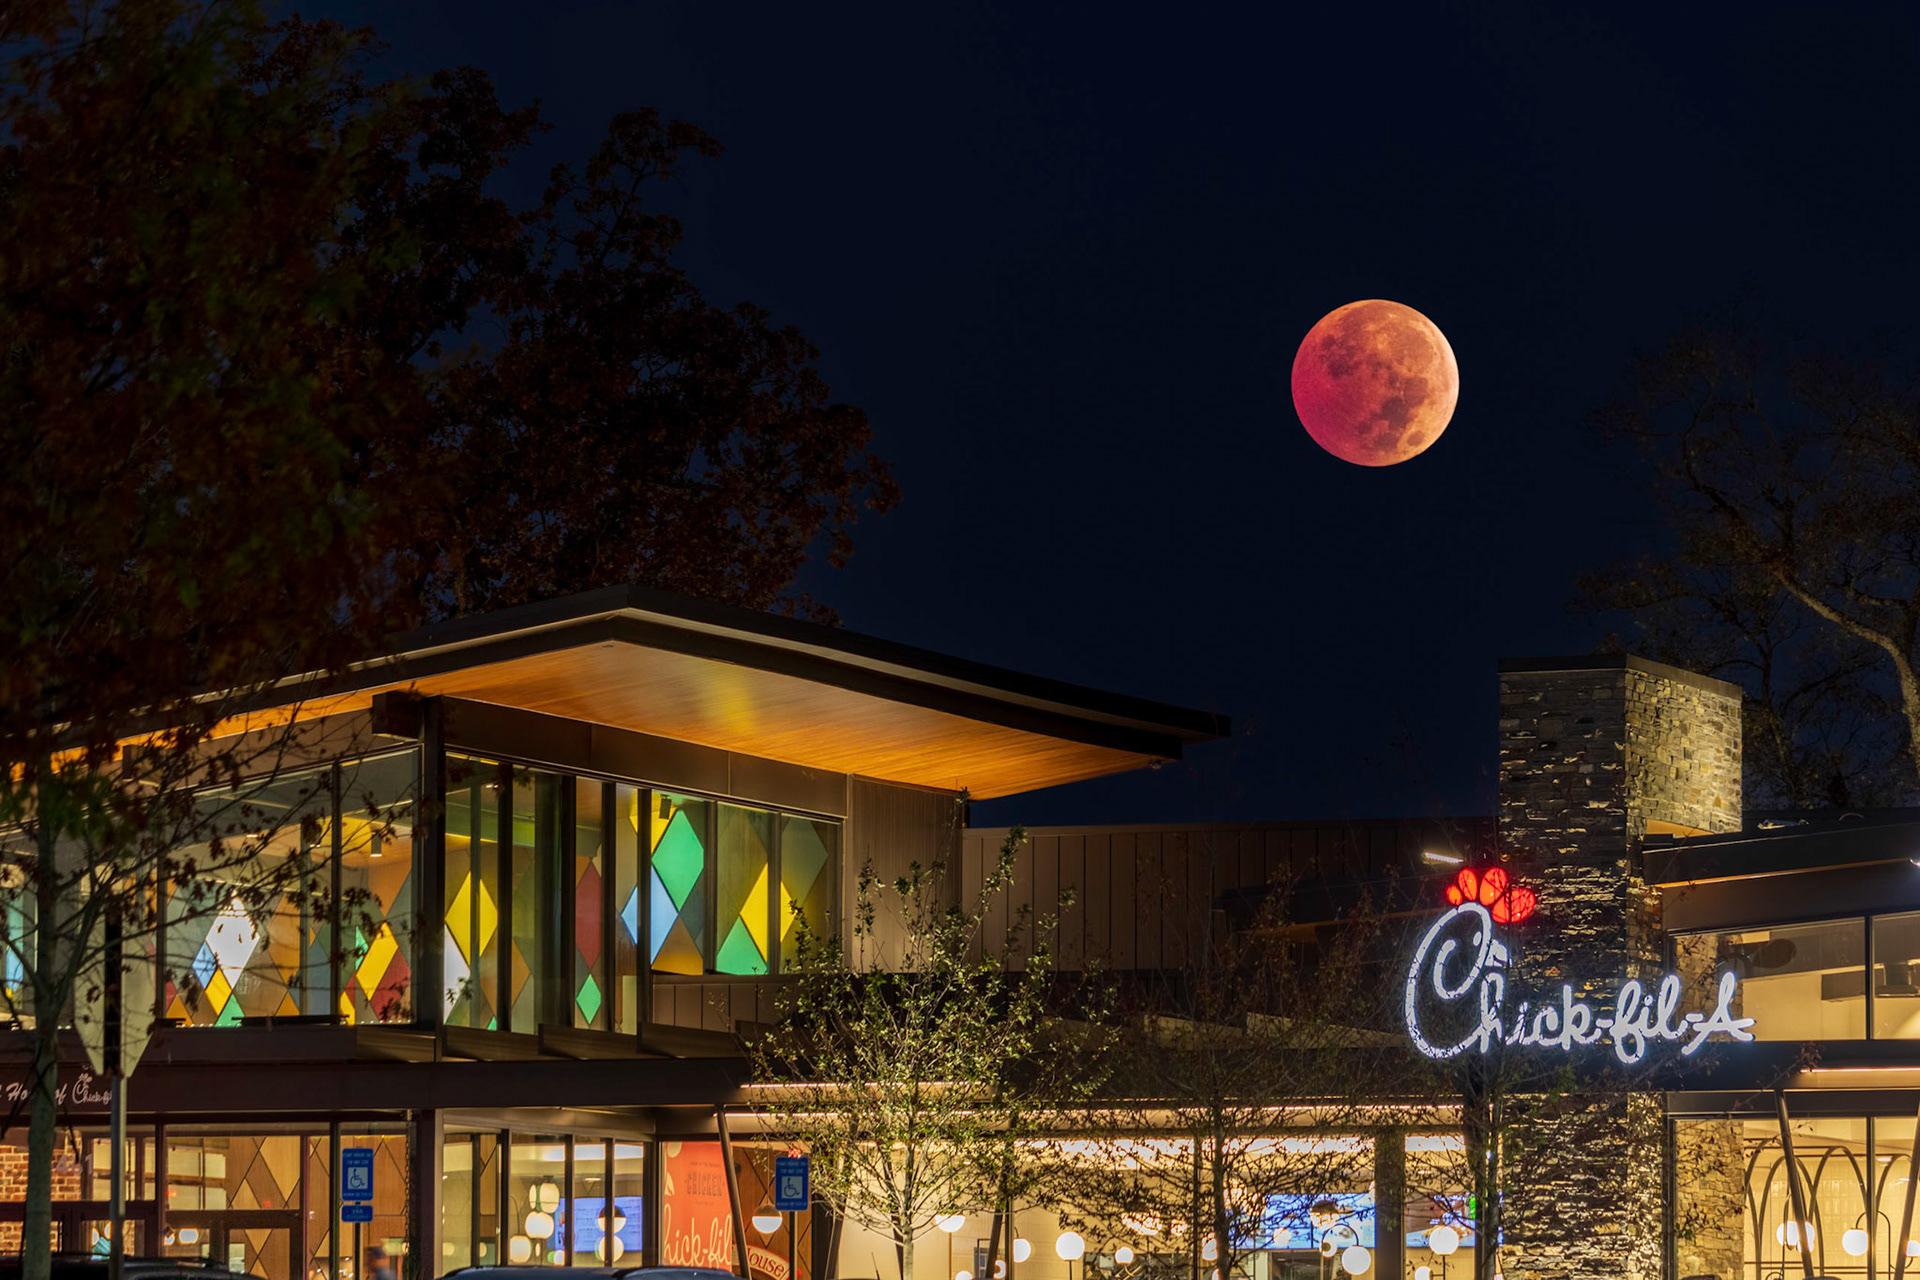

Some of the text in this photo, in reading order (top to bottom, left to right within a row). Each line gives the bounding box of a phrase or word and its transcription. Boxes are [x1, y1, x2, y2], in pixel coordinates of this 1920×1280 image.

[1405, 901, 1756, 1064] Chick-fil-A
[72, 1078, 112, 1105] Chick-fil
[663, 1203, 732, 1269] hick-fil
